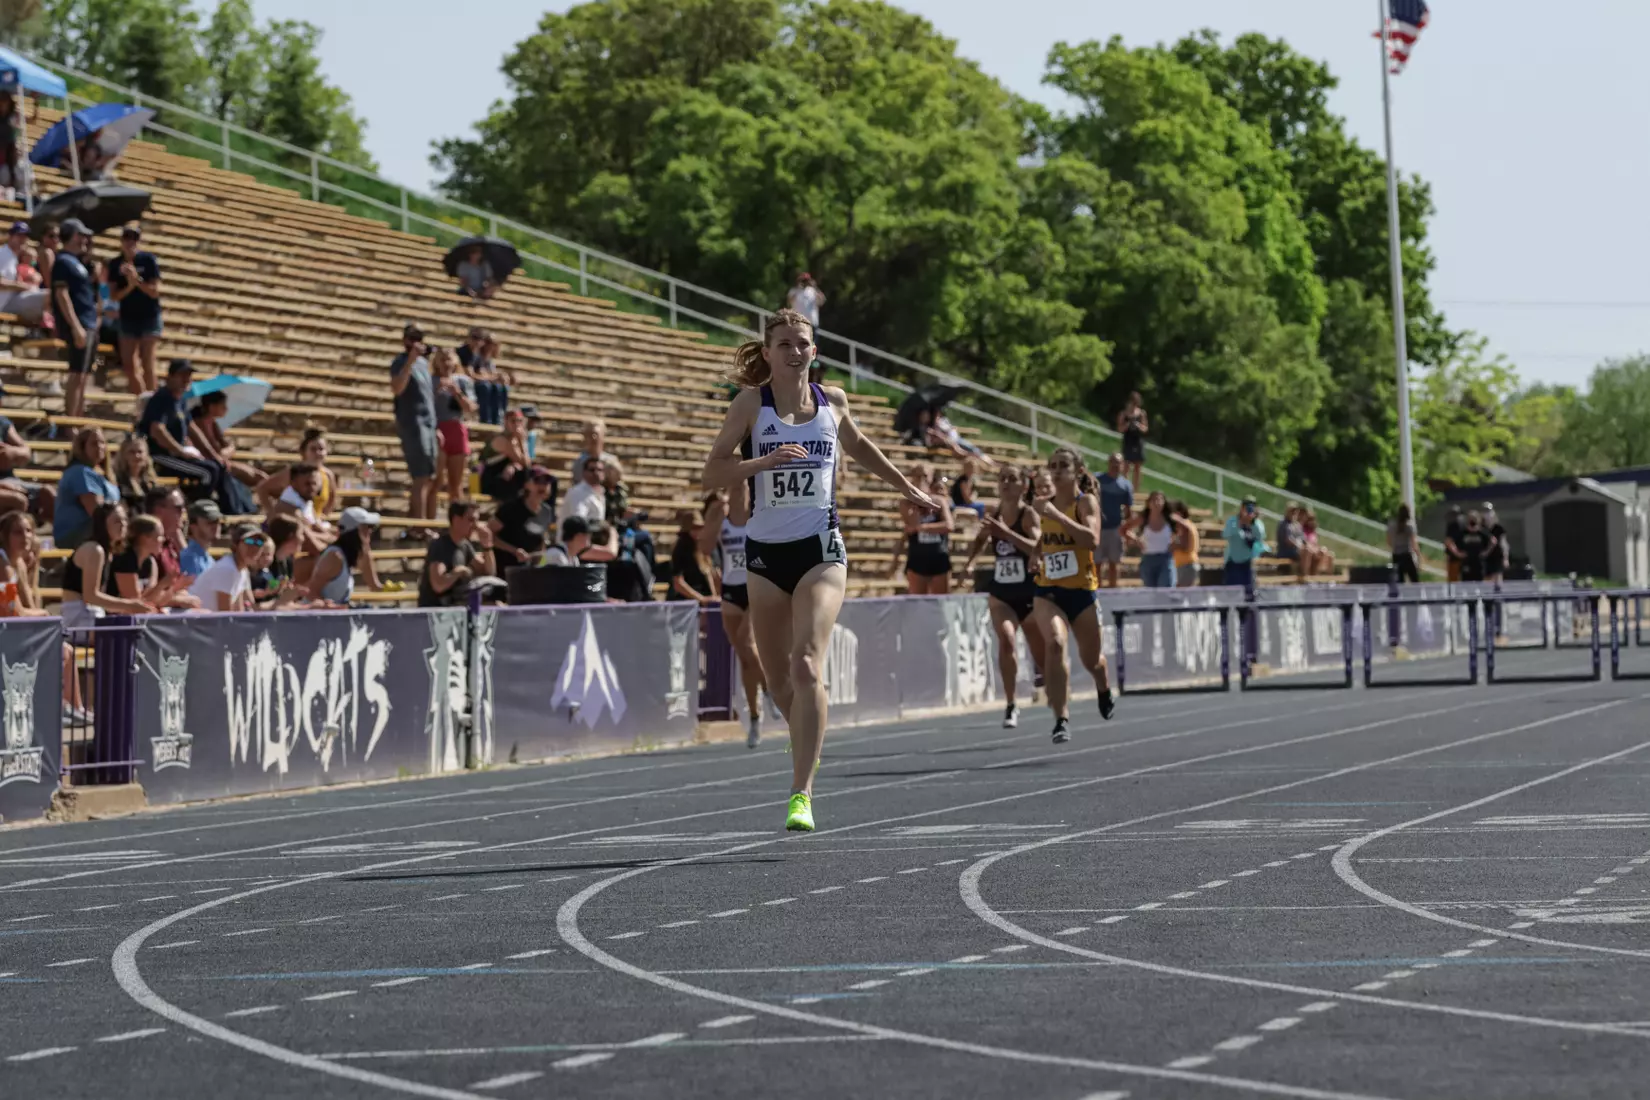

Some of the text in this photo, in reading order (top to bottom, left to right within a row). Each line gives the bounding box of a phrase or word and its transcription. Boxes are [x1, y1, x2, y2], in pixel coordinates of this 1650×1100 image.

[802, 440, 833, 456] STATE
[773, 470, 815, 498] 542
[827, 531, 841, 558] 4
[999, 561, 1020, 577] 264
[1048, 553, 1069, 573] 357
